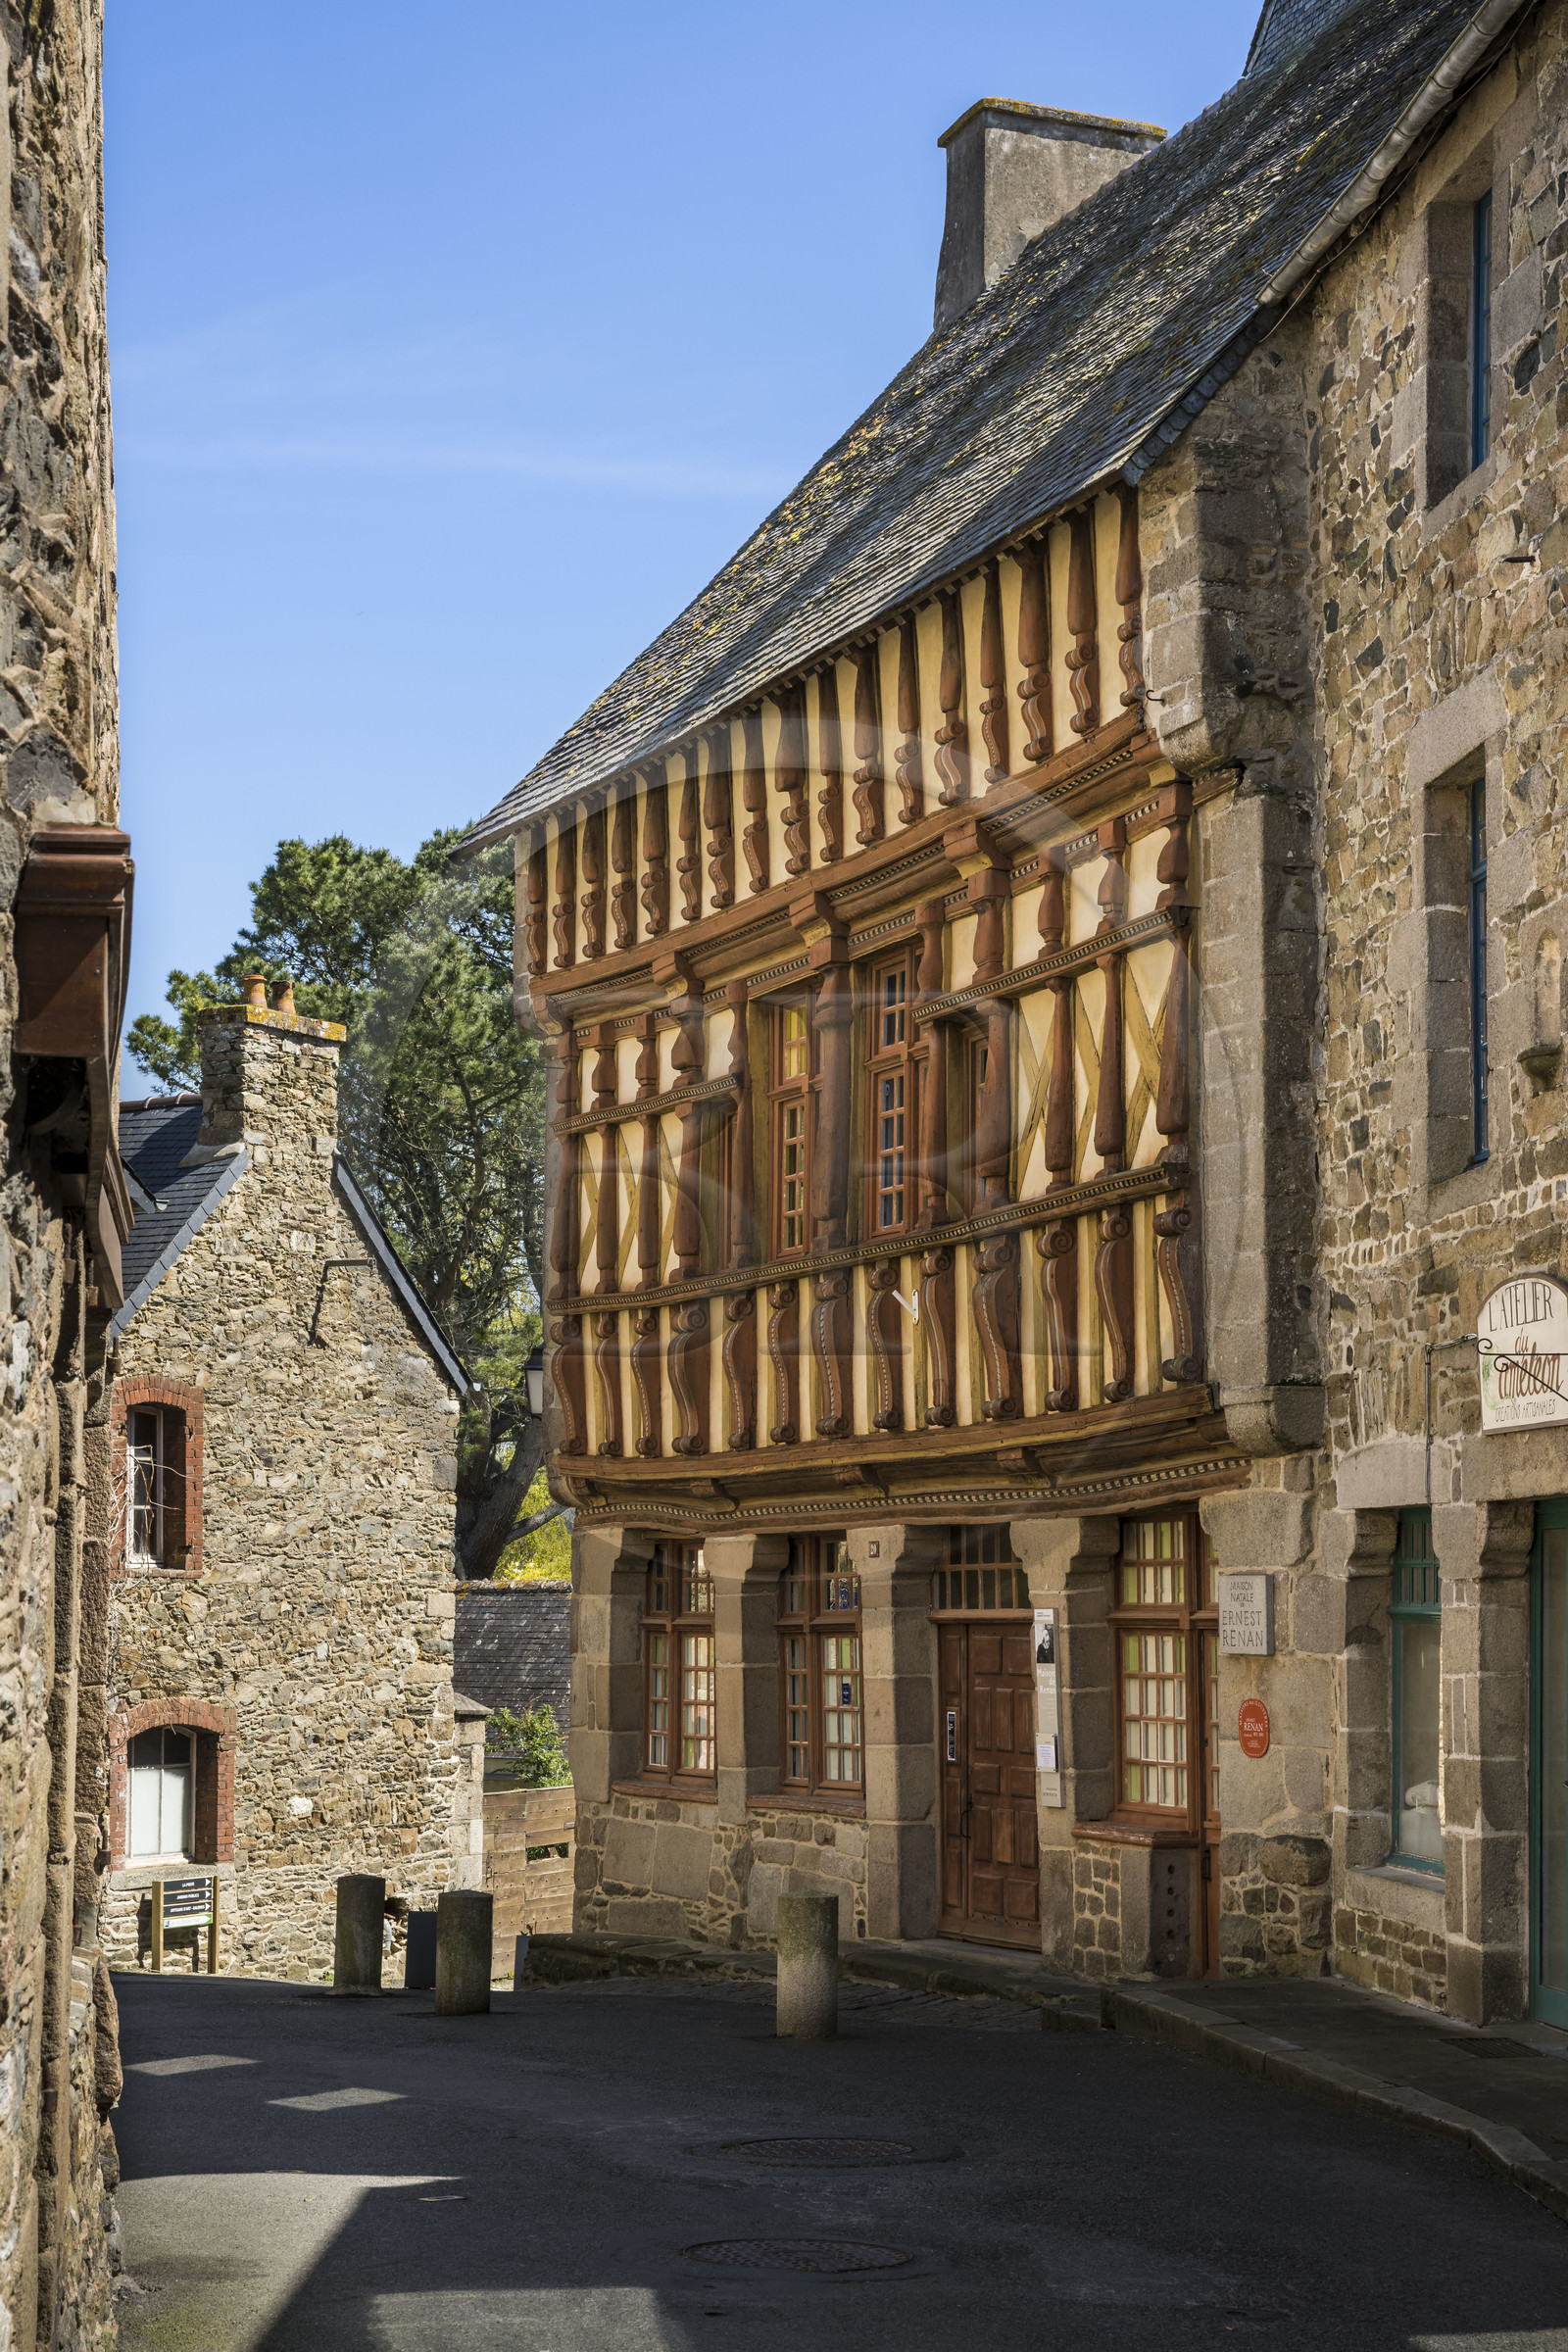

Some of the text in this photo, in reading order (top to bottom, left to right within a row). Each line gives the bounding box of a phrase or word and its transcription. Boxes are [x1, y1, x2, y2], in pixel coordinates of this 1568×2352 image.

[1488, 1281, 1554, 1333] L'ATELIER
[1514, 1327, 1529, 1354] du
[1230, 1581, 1253, 1591] MAISON
[1230, 1592, 1253, 1602] NATALE
[1222, 1610, 1262, 1627] ERNEST
[1222, 1629, 1263, 1647] RENAN
[1037, 1668, 1055, 1678] Maison
[1049, 1677, 1055, 1686] de
[1039, 1685, 1056, 1694] Renan
[1244, 1722, 1263, 1732] RENAN
